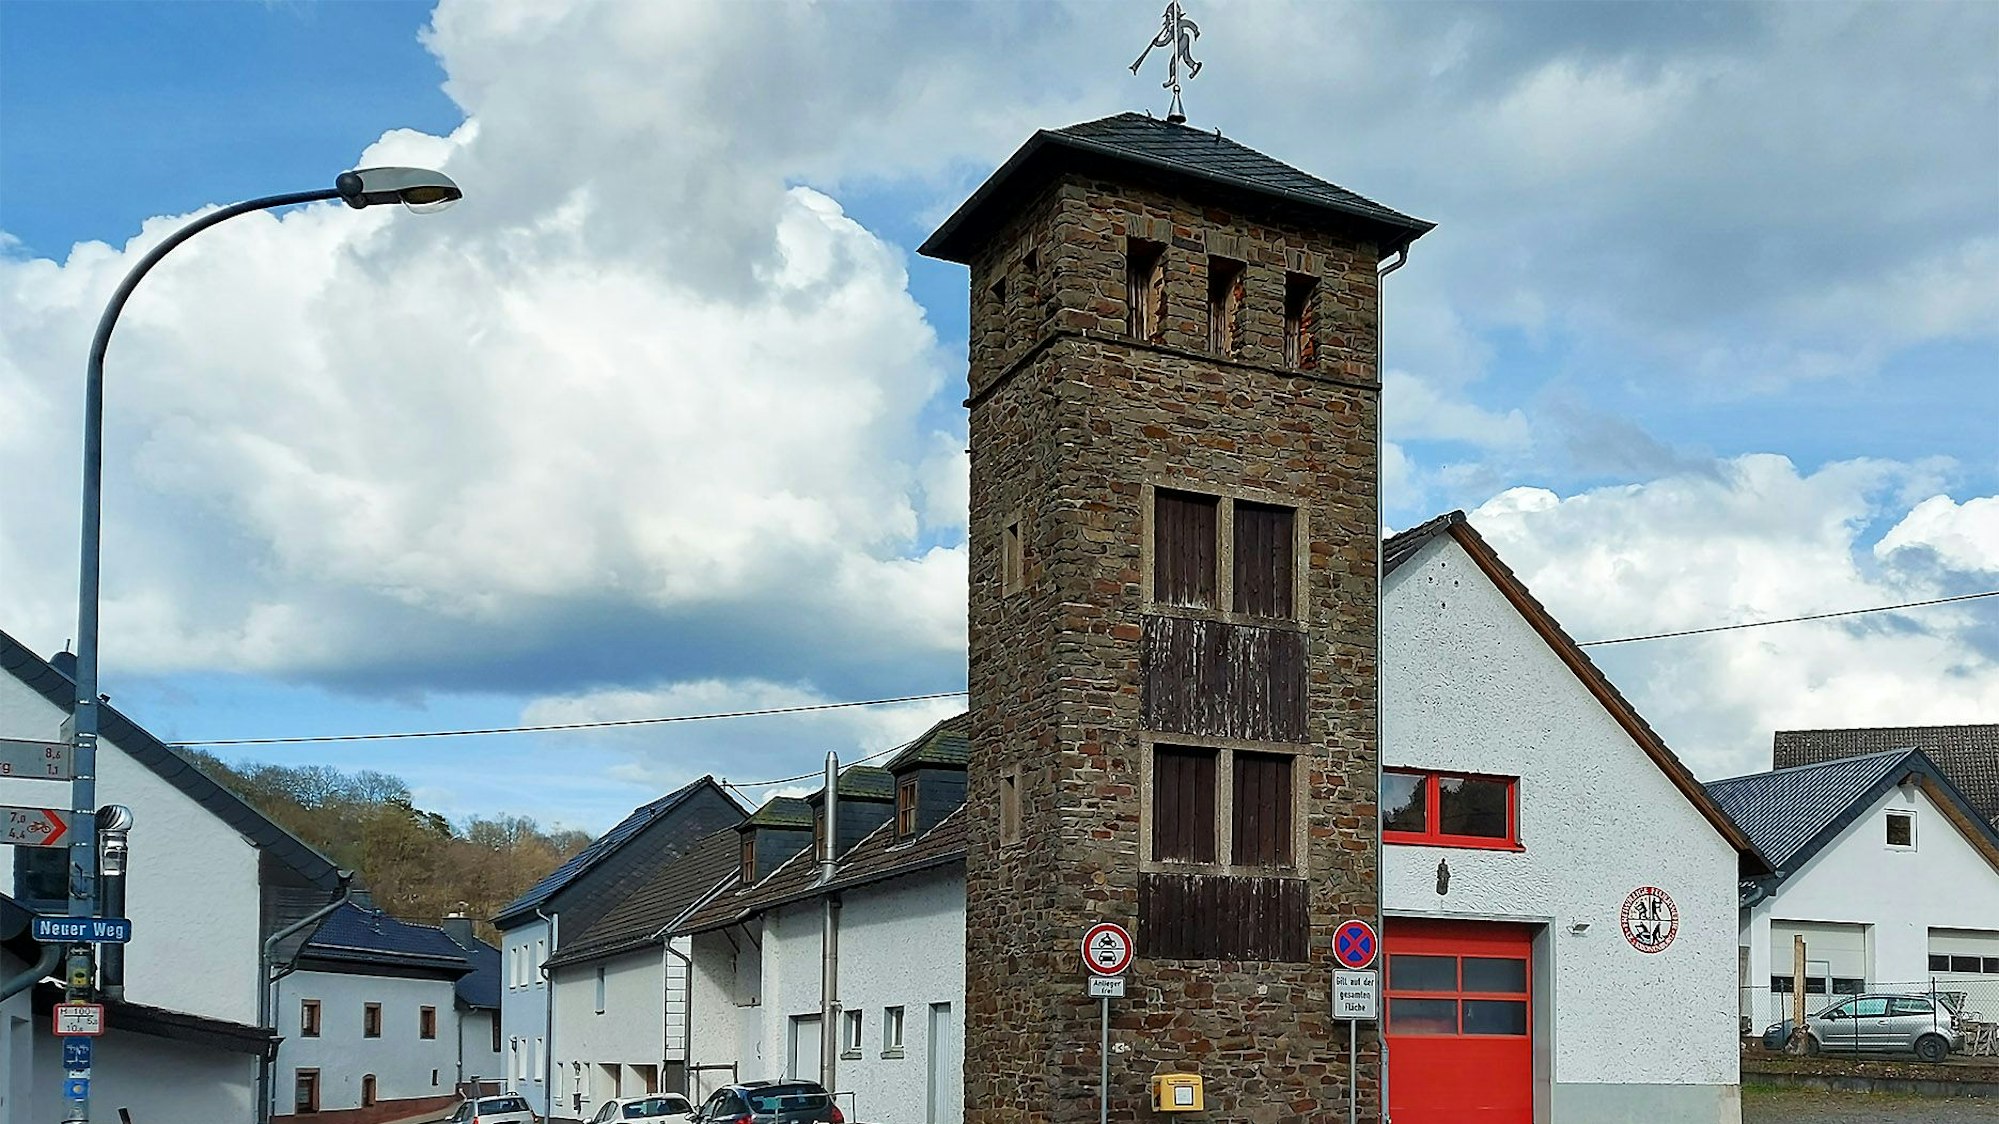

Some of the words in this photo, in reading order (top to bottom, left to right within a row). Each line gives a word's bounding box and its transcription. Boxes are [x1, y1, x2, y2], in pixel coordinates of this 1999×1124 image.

[40, 920, 87, 936] Neuer
[93, 922, 124, 939] Weg
[1363, 977, 1374, 986] der
[1340, 990, 1371, 1001] gesamten
